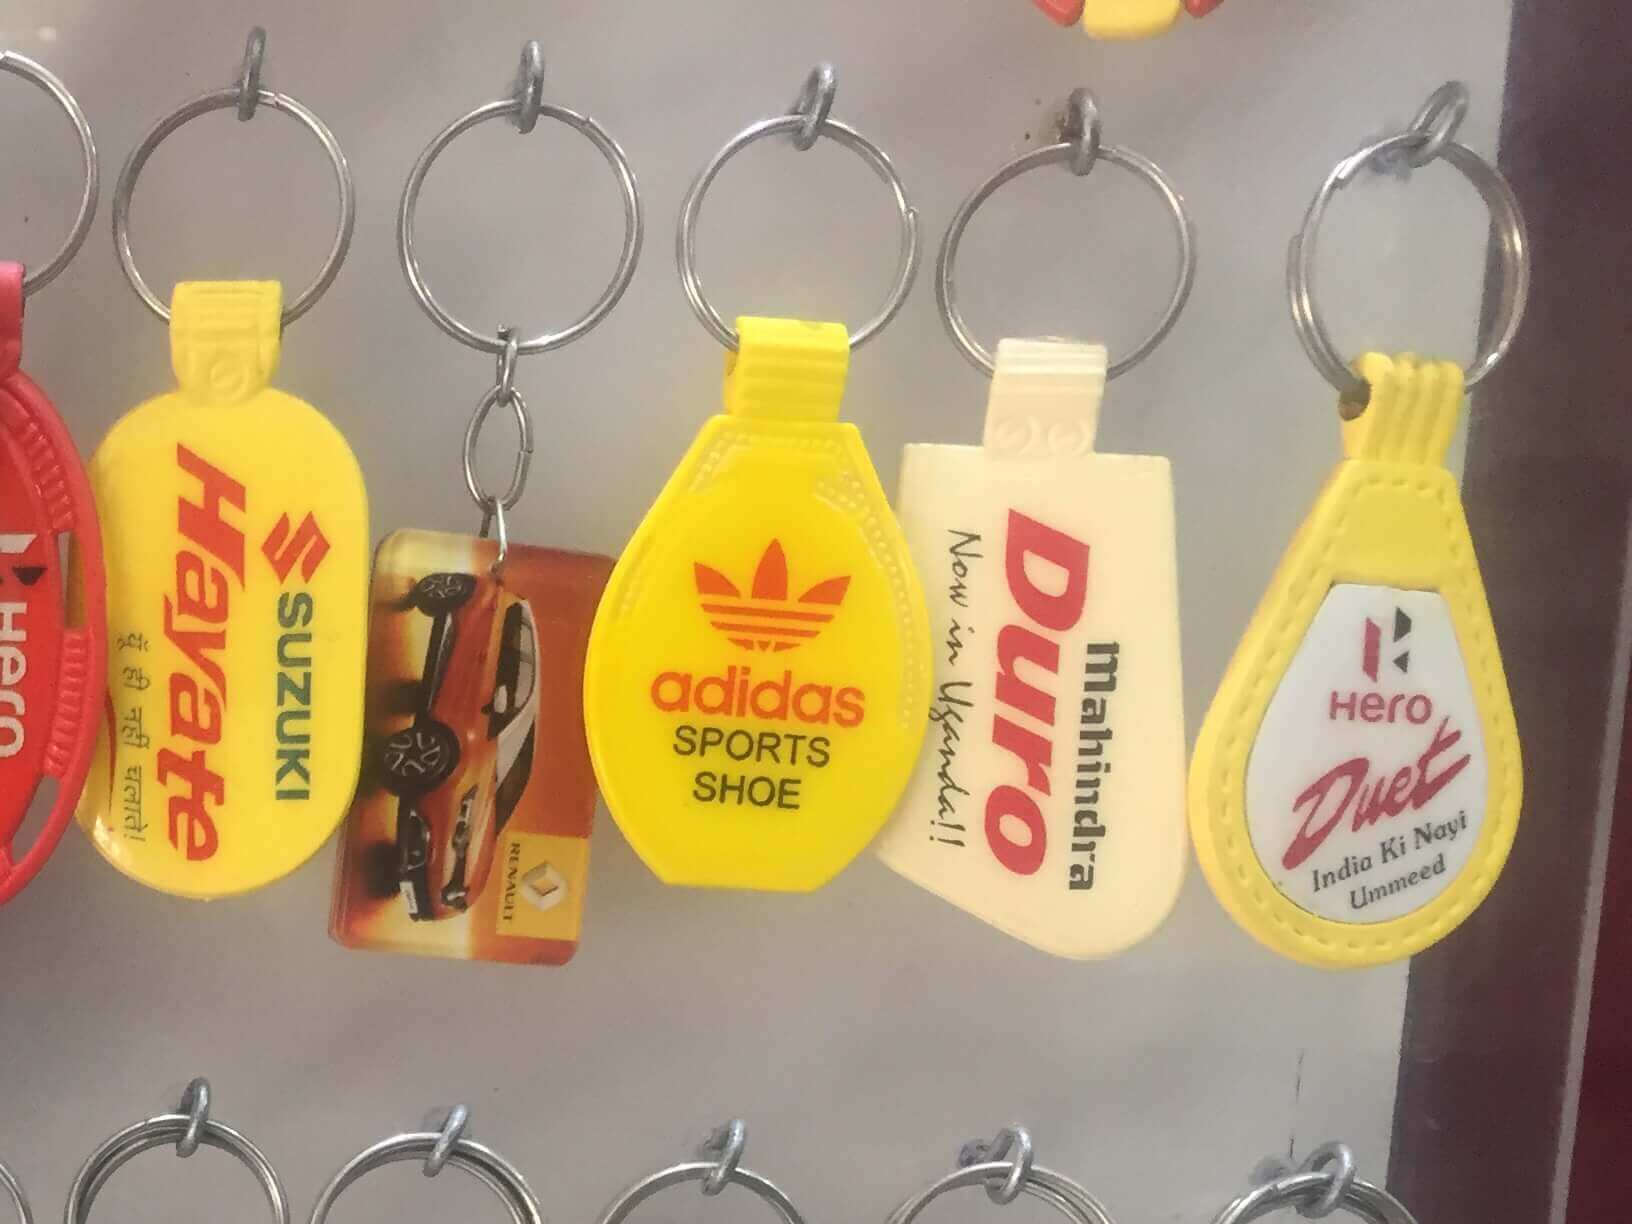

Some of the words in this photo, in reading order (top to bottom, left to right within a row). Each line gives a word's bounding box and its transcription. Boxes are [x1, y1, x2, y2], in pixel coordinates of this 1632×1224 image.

[947, 528, 983, 608] Now
[156, 442, 246, 862] Hayate
[946, 617, 975, 666] in
[275, 592, 314, 800] SUZUKI
[650, 664, 866, 729] adidas
[984, 508, 1091, 876] Duro
[1329, 690, 1433, 726] Hero
[672, 725, 831, 769] SPORTS
[1068, 641, 1120, 890] mahindra
[692, 771, 802, 810] SHOE
[1282, 716, 1472, 870] Duet
[502, 842, 521, 924] RENAULT
[1311, 855, 1373, 892] India
[1380, 836, 1407, 865] Ki
[1414, 810, 1468, 851] Nayi
[1350, 853, 1447, 910] Ummeed
